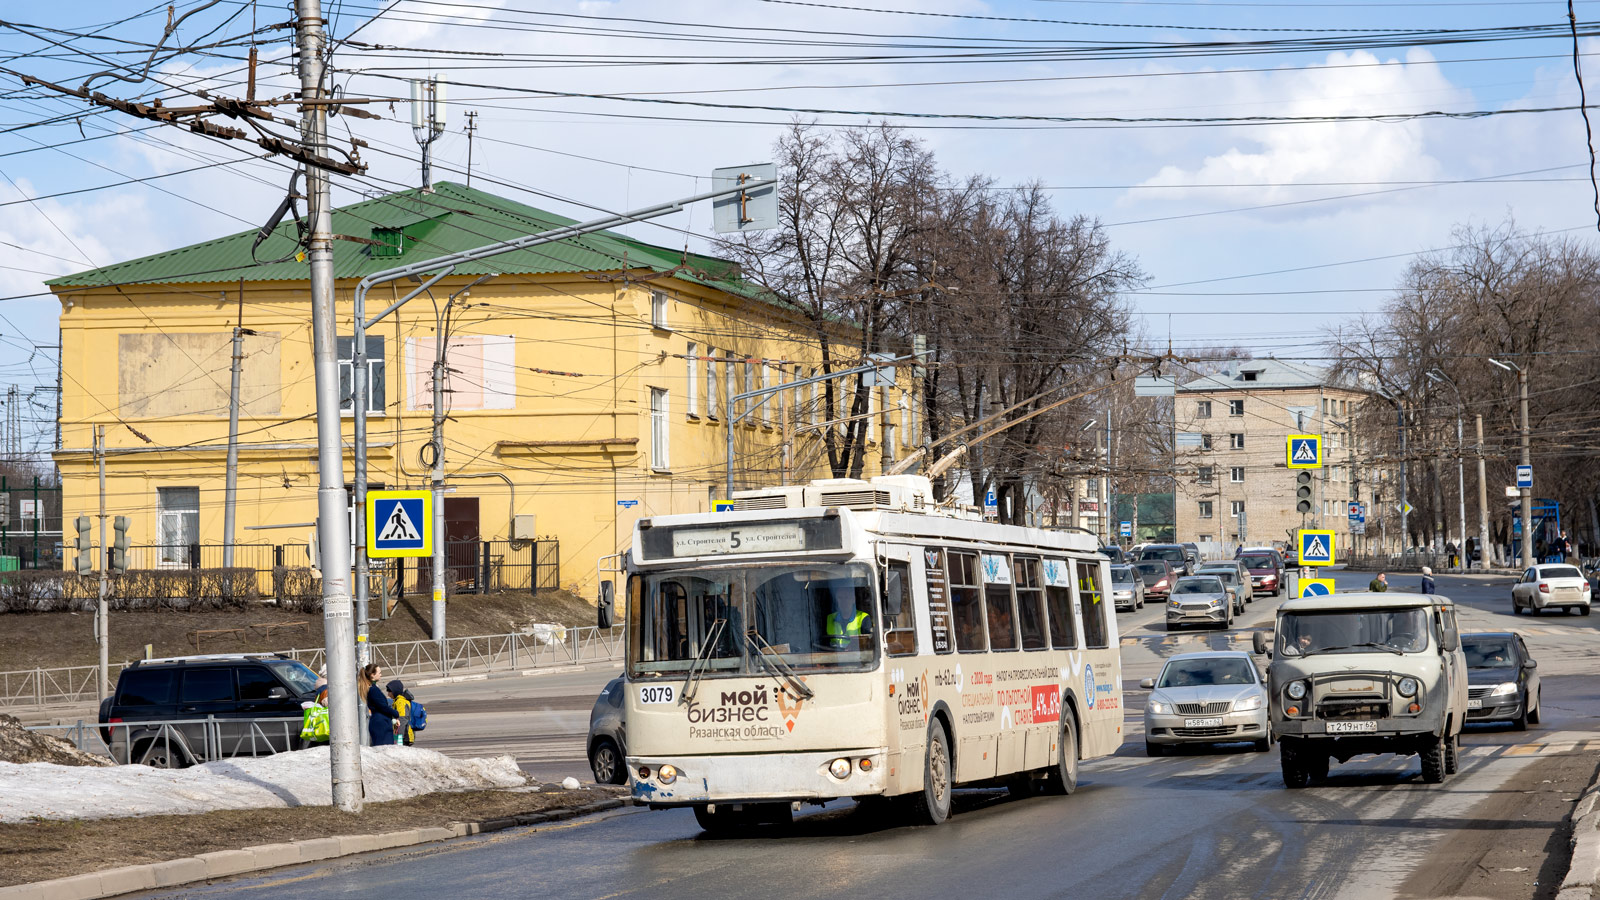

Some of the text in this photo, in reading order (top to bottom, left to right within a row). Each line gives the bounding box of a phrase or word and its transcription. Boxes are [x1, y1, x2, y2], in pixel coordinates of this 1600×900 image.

[688, 537, 726, 546] Строителей
[730, 531, 741, 548] 5
[757, 533, 796, 542] Строителей
[934, 669, 956, 686] mb-62.ru
[974, 672, 983, 684] 2020
[641, 688, 673, 703] 3079
[720, 684, 767, 706] мой
[906, 676, 919, 698] мой
[898, 694, 920, 715] бизнес
[962, 689, 993, 708] СПЕЦИАЛЬНЫЙ
[1036, 693, 1046, 716] 4%
[1050, 692, 1060, 715] 6%
[687, 701, 768, 723] бизнес
[1015, 708, 1032, 725] СТАВКЕ
[690, 724, 784, 738] Рязанская область
